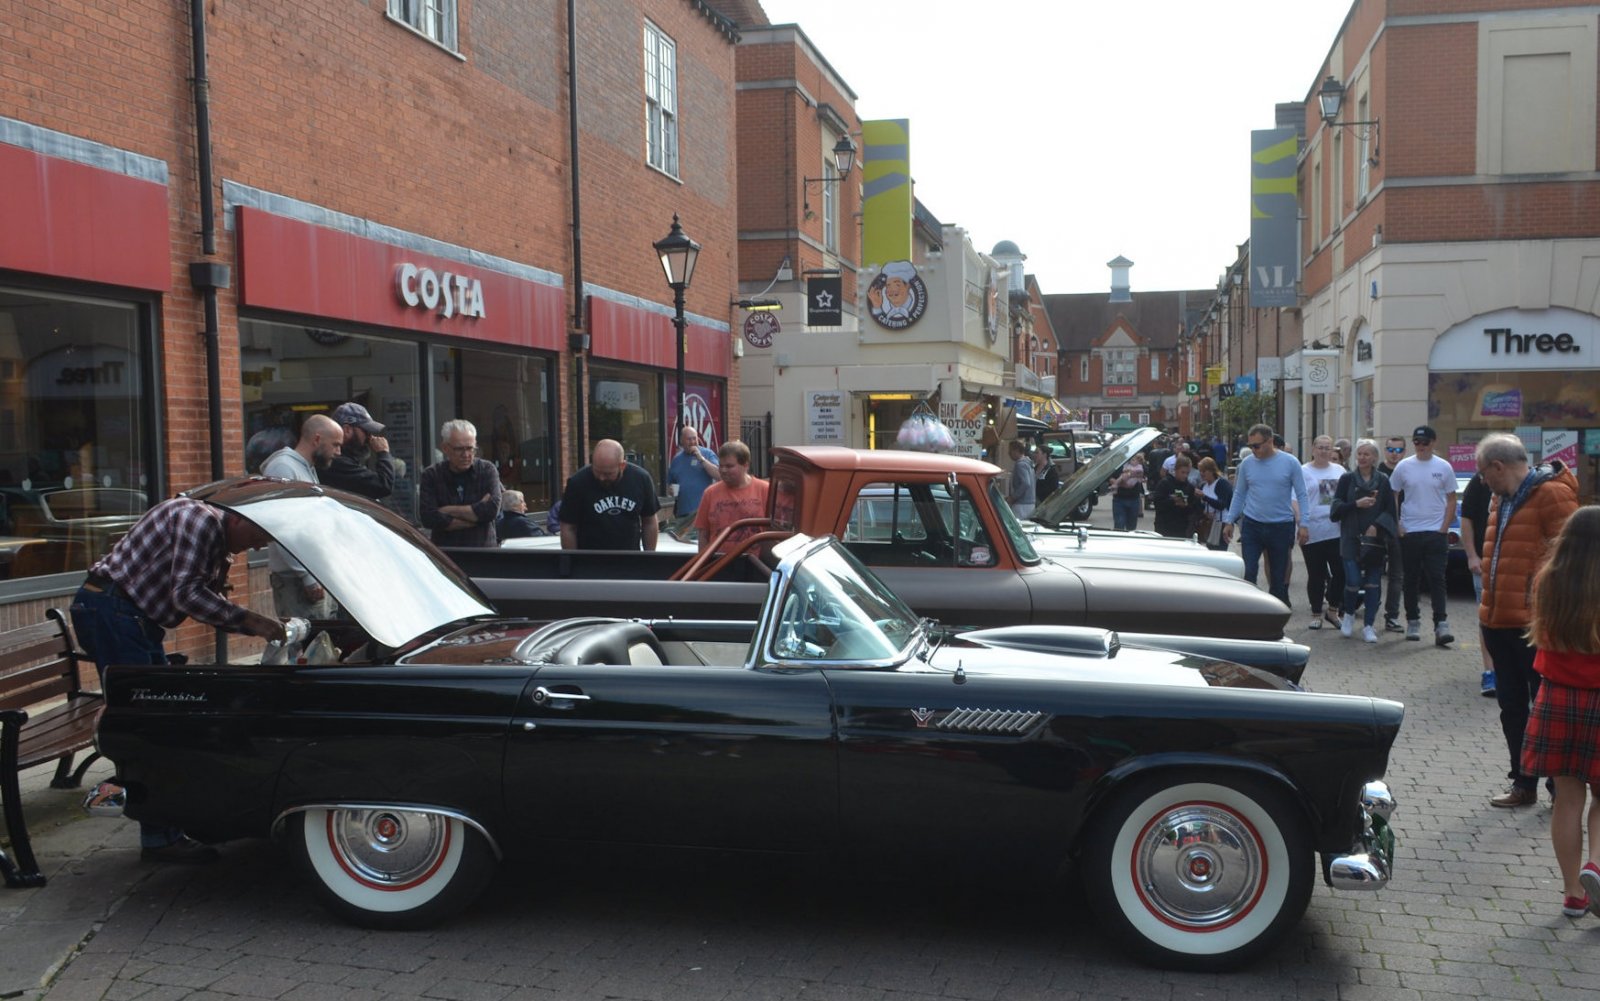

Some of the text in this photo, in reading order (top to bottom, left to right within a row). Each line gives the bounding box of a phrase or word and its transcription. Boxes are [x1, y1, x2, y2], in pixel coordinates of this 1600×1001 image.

[1256, 265, 1295, 288] VL
[395, 263, 486, 319] COSTA
[878, 280, 926, 328] CATERING PERFECTION
[750, 313, 773, 325] COSTA
[1309, 358, 1329, 382] 3
[1188, 383, 1199, 394] D
[940, 403, 958, 418] GIANT
[1544, 433, 1567, 446] Down
[594, 496, 637, 514] OAKLEY
[130, 688, 209, 702] Thunderbird
